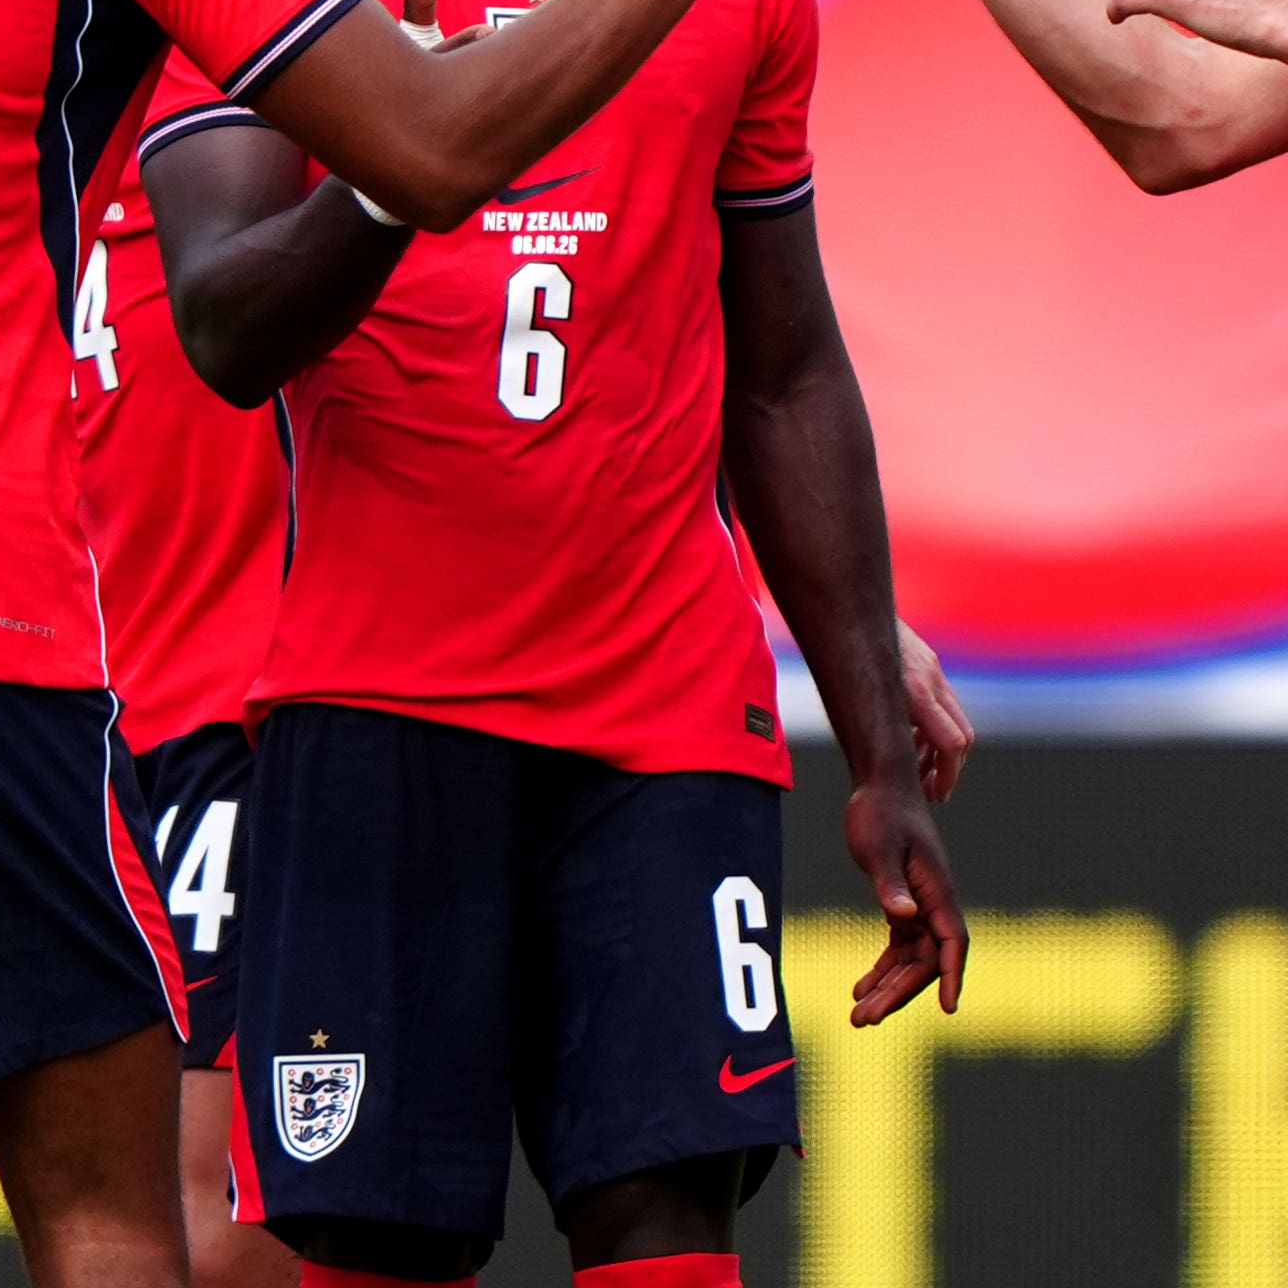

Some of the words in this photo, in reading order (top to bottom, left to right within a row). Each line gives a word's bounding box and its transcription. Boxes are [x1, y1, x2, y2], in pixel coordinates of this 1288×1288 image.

[483, 211, 524, 232] NEW
[525, 211, 608, 232] ZEALAND
[511, 234, 579, 255] 06.06.26
[71, 238, 120, 399] 4
[496, 261, 572, 422] 6
[712, 875, 779, 1033] 6
